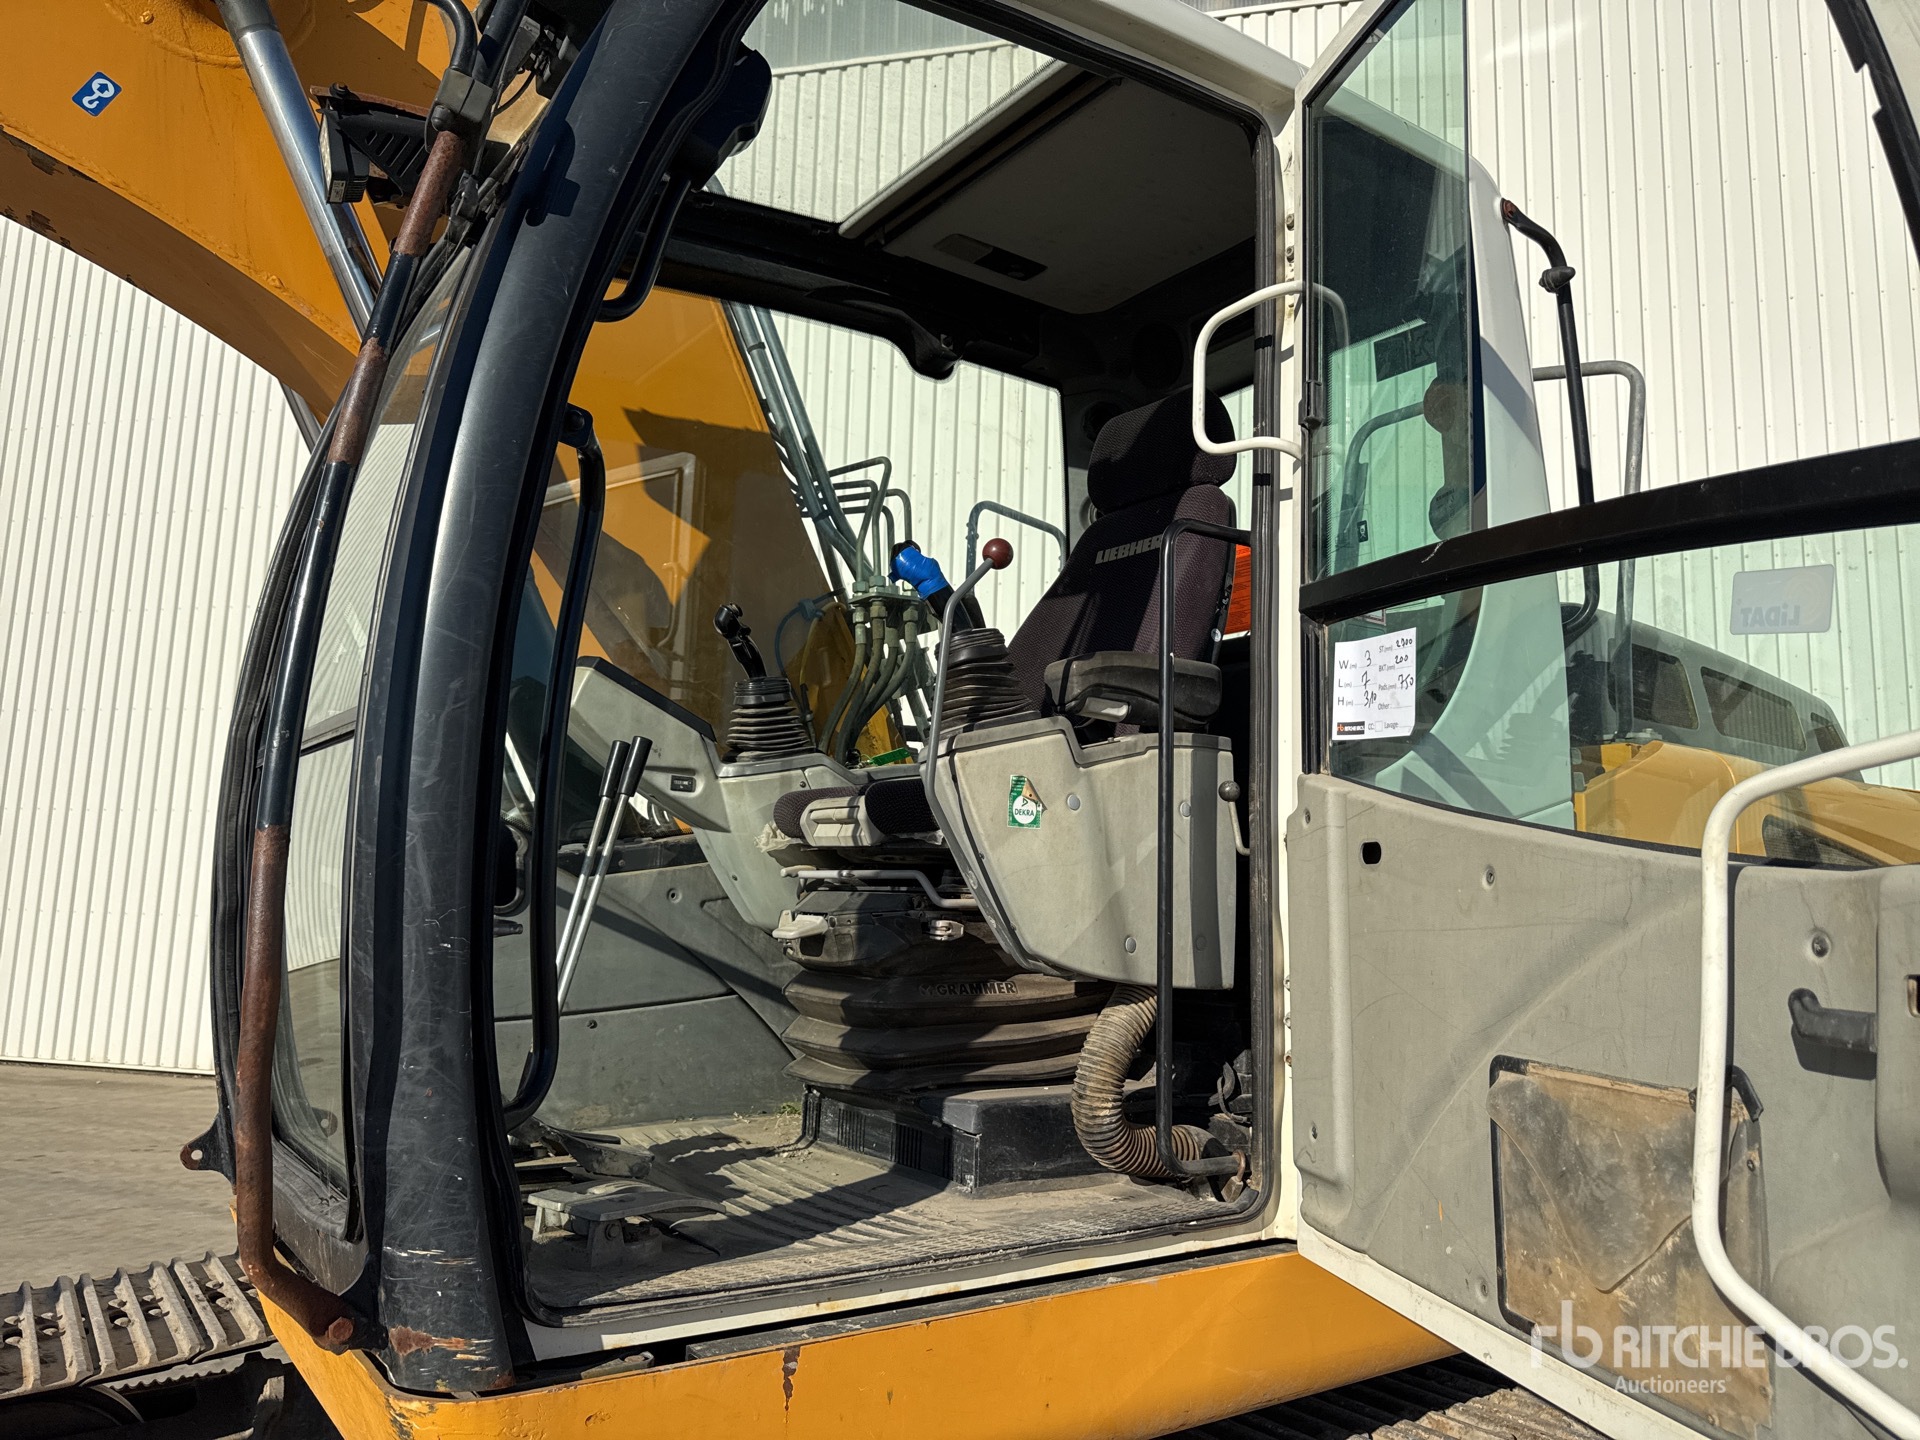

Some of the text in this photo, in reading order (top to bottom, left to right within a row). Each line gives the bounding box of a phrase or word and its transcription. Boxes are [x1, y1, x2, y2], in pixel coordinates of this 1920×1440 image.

[1095, 534, 1163, 564] LIEBHER
[1365, 650, 1372, 667] 3
[1339, 660, 1349, 670] W
[1338, 679, 1343, 687] L
[1338, 696, 1344, 705] H
[1015, 808, 1034, 817] DEKRA
[936, 981, 1017, 996] GRAMMER
